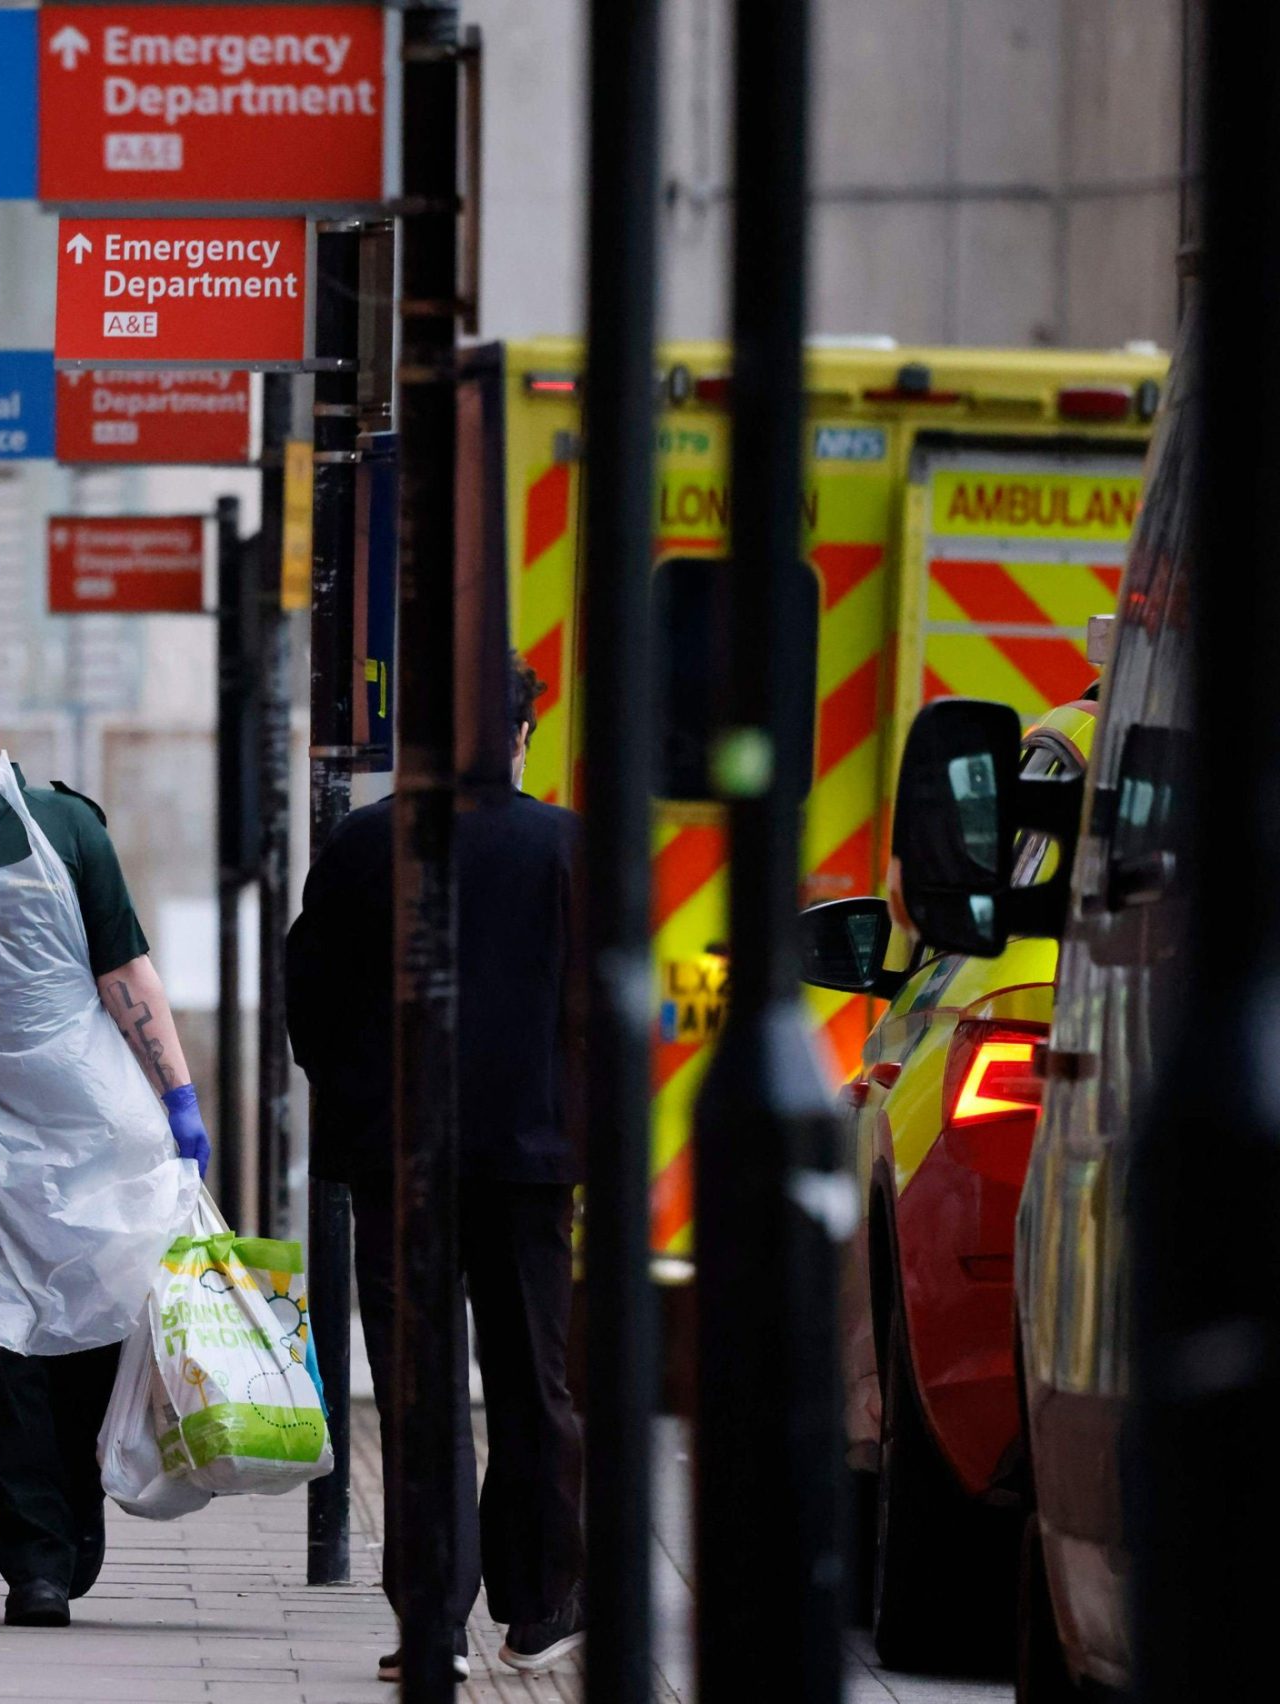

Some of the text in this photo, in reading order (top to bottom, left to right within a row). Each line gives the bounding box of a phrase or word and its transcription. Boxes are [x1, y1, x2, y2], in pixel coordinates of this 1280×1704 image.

[103, 27, 351, 75] Emergency
[103, 79, 376, 123] Department
[104, 234, 280, 269] Emergency
[103, 271, 298, 302] Department
[107, 314, 156, 335] A&E
[91, 391, 247, 419] Department
[819, 431, 882, 457] NHS
[948, 484, 1137, 528] AMBULAN
